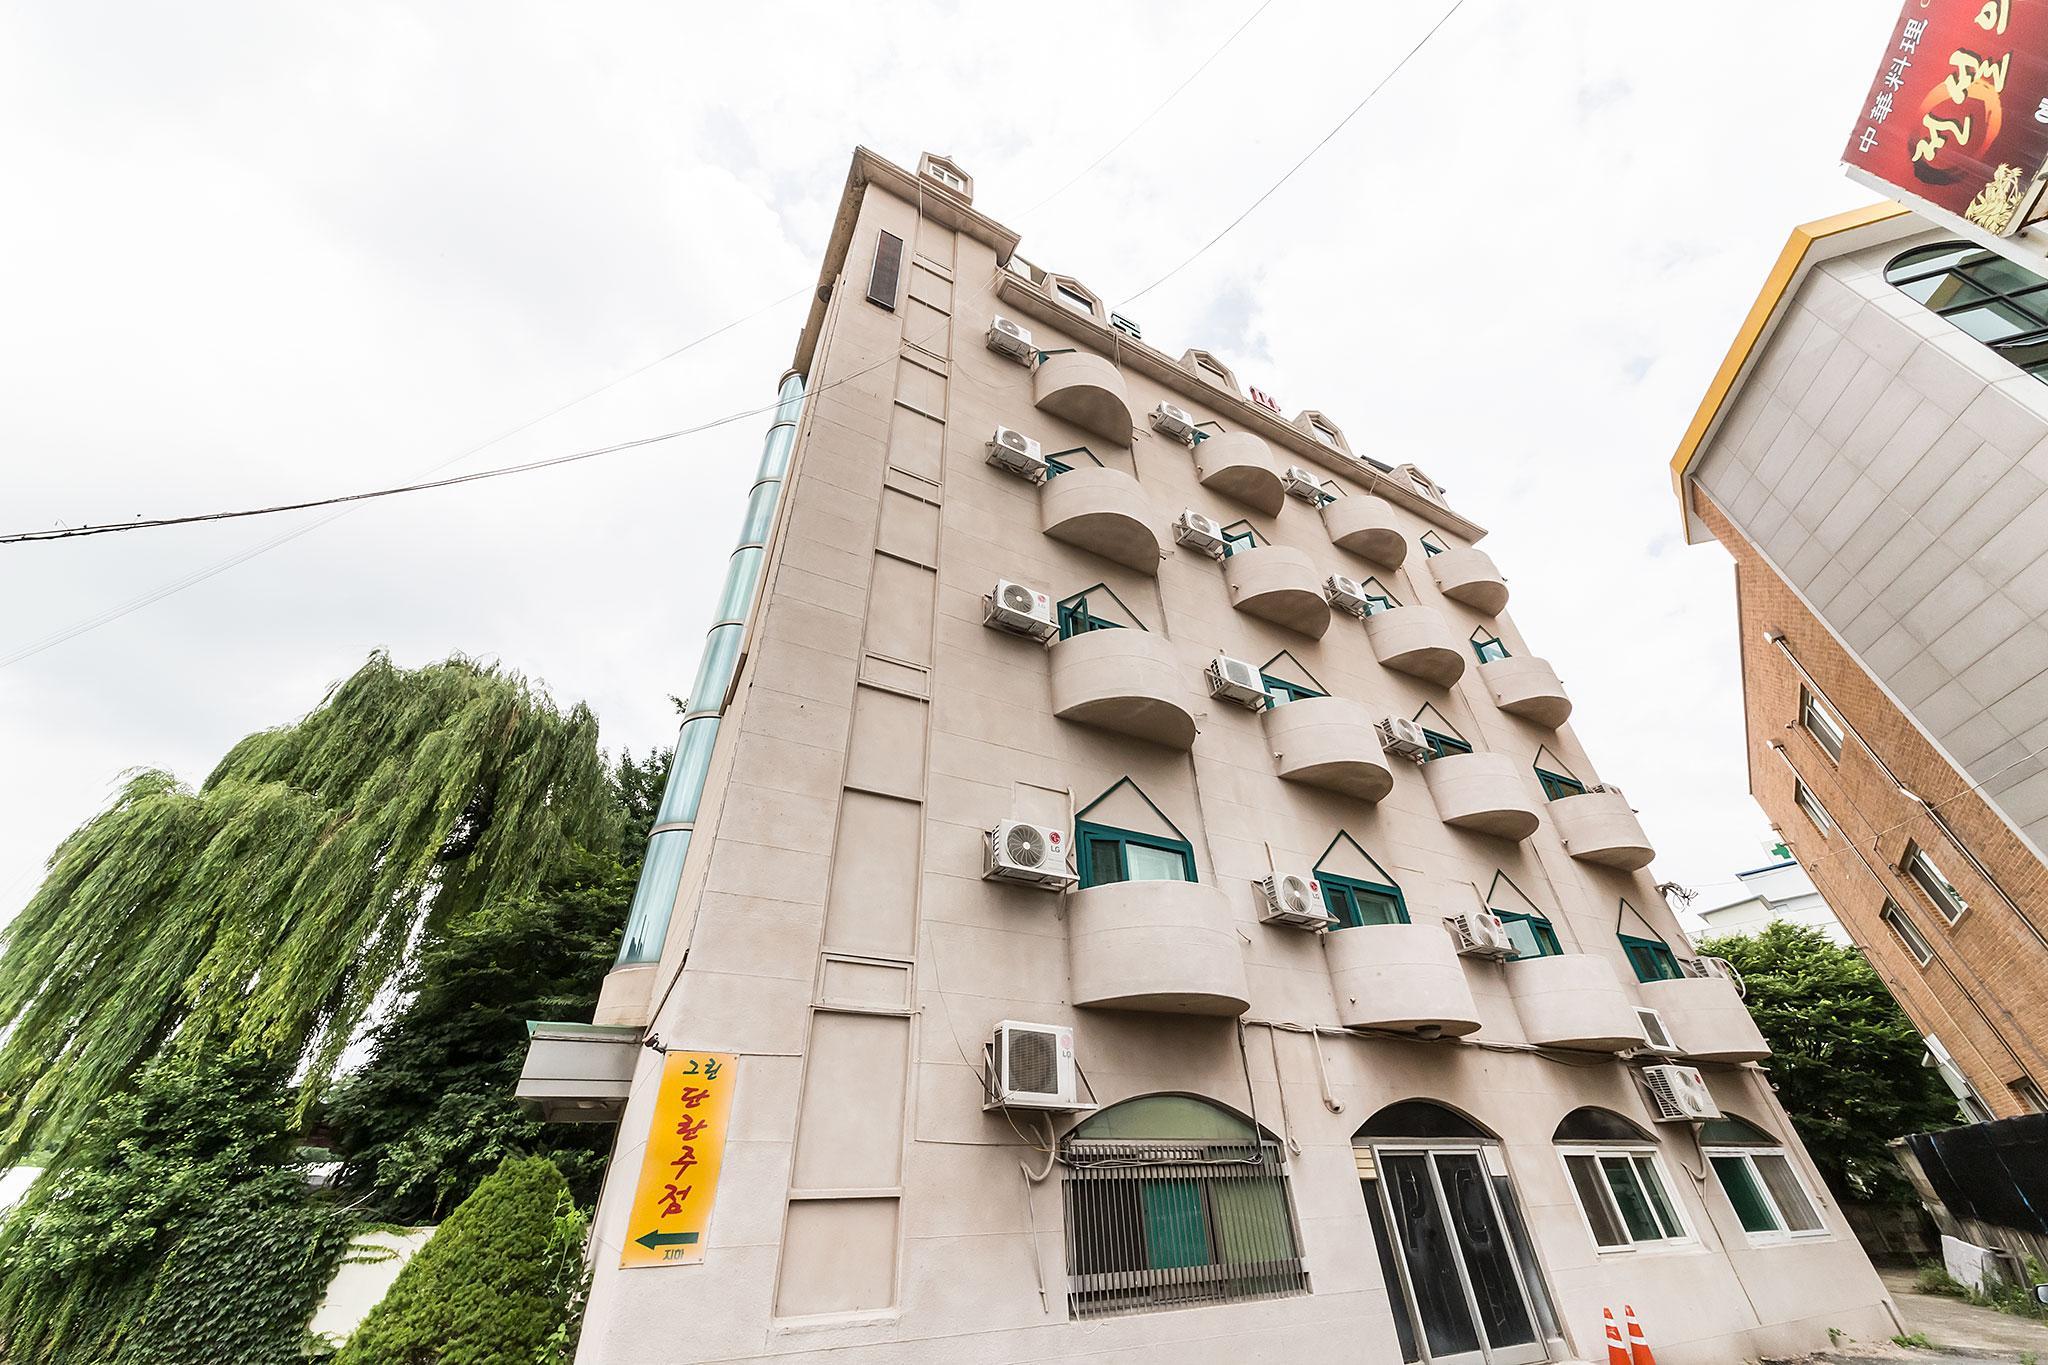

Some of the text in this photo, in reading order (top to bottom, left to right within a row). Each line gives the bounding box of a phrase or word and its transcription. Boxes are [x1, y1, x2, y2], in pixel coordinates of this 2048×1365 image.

[1858, 18, 1929, 153] 中華料理
[1050, 845, 1061, 853] LG
[657, 1086, 710, 1219] 단란주점
